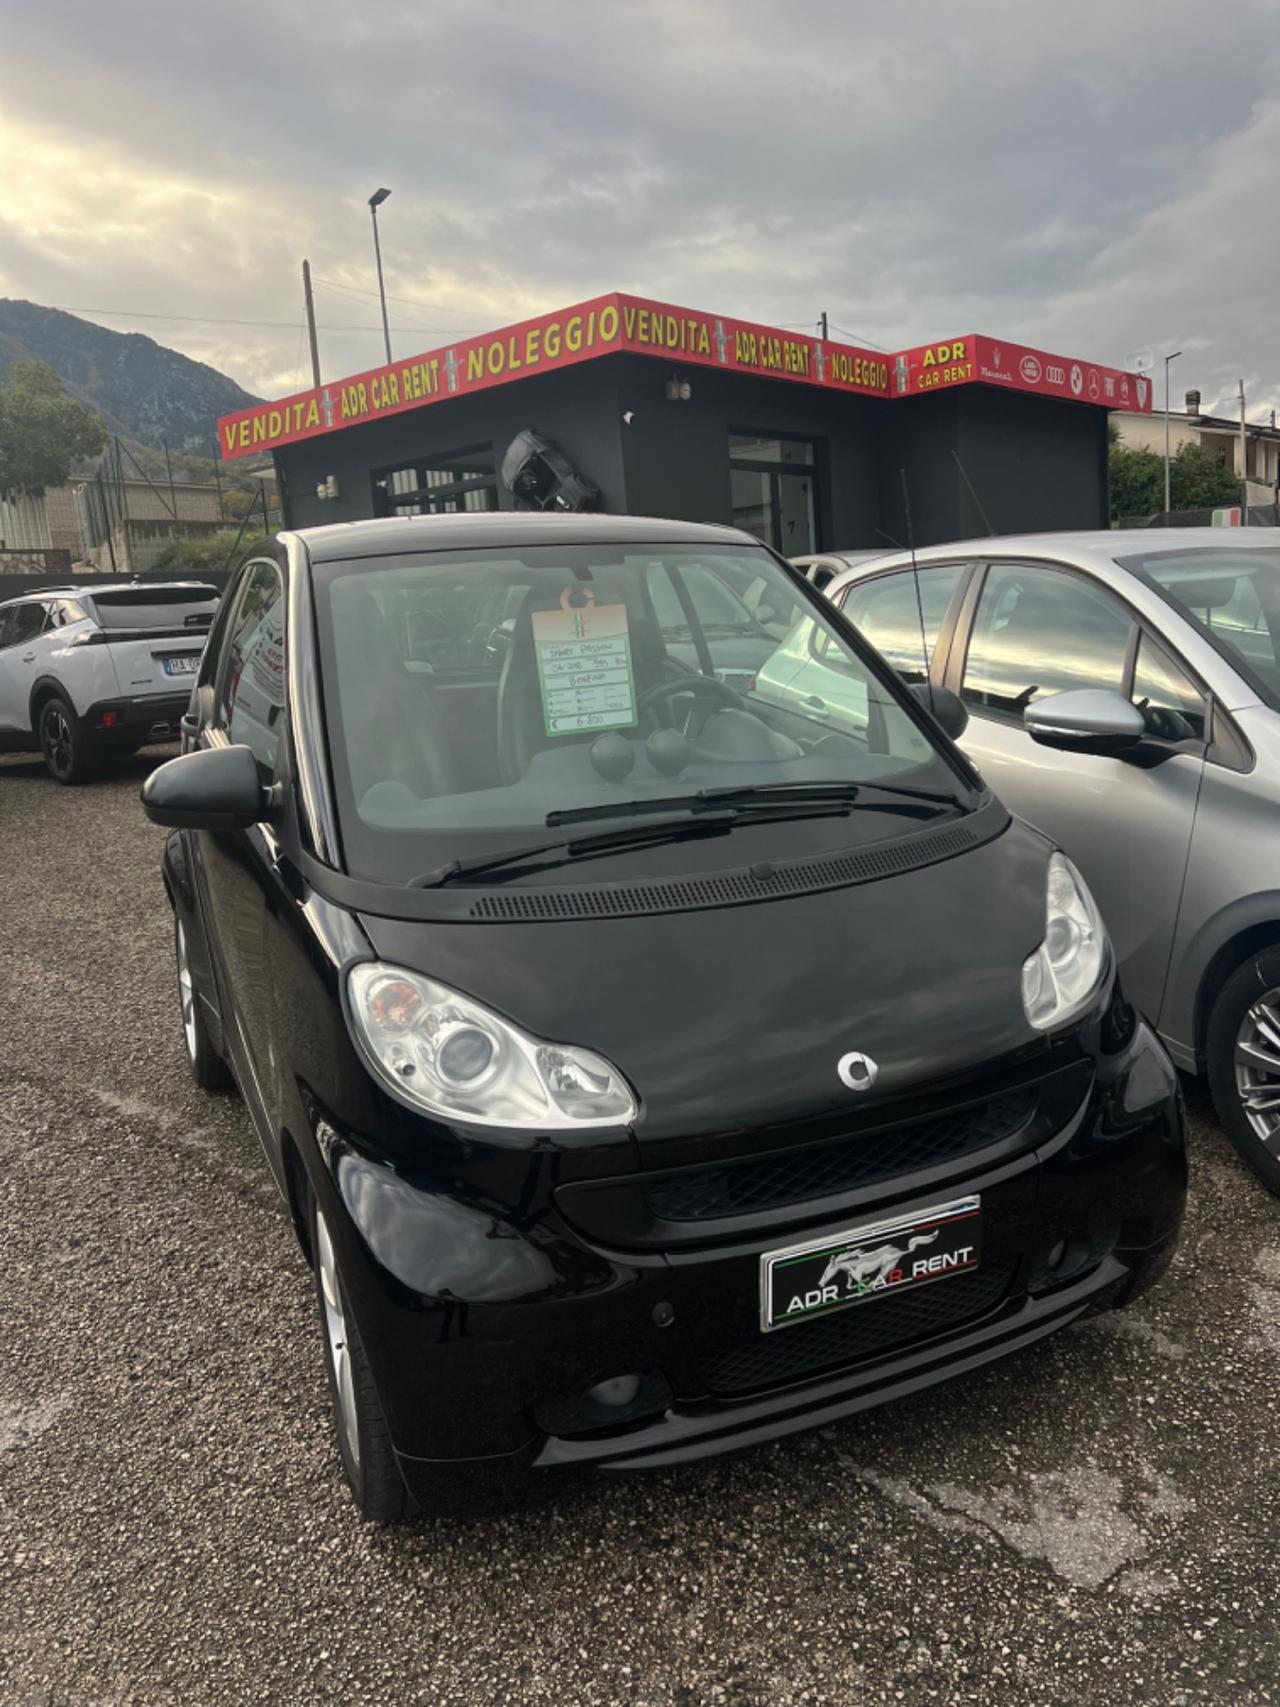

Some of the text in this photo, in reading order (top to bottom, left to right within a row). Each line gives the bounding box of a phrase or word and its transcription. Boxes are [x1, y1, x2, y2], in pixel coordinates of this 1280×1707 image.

[224, 305, 620, 451] VENDITA ADR CAR RENT NOLEGGIO
[623, 305, 888, 390] VENDITA ADR CAR RENT NOLEGGIO
[917, 363, 973, 389] CAR RENT
[923, 341, 966, 368] ADR
[786, 1284, 838, 1313] ADR
[912, 1246, 974, 1277] RENT
